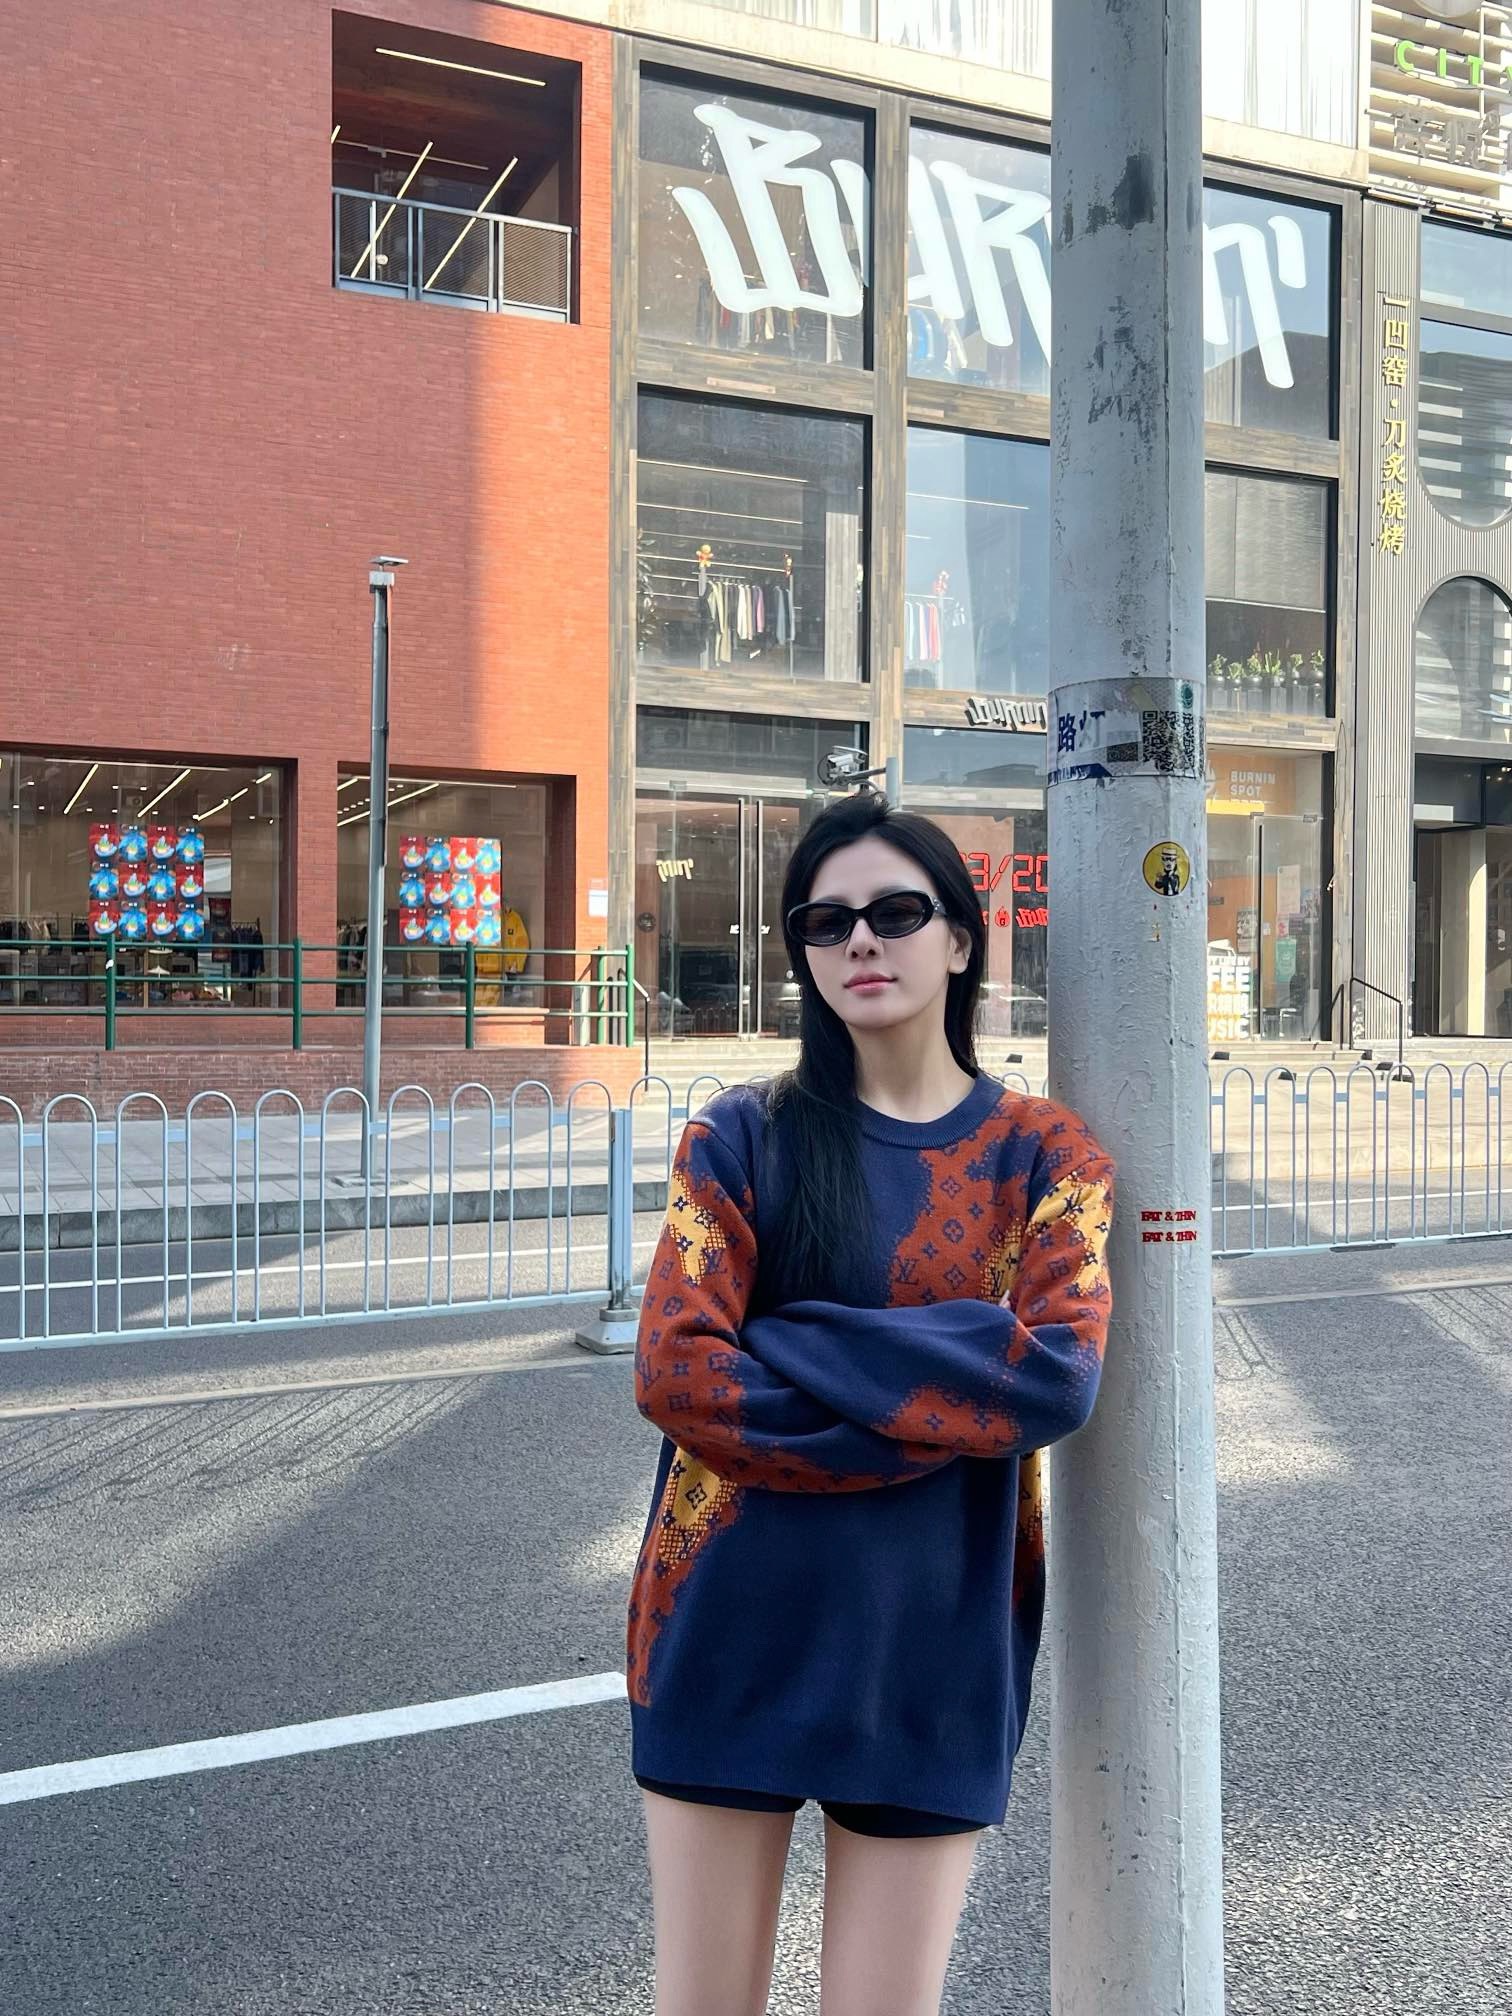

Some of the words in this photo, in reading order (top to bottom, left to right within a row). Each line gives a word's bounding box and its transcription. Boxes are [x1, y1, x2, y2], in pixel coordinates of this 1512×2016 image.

[1230, 771, 1276, 785] BURNIN
[1230, 784, 1263, 797] SPOT
[1165, 1211, 1174, 1221] &
[1175, 1210, 1196, 1221] THIN
[1165, 1231, 1175, 1242] &
[1176, 1231, 1197, 1242] THIN
